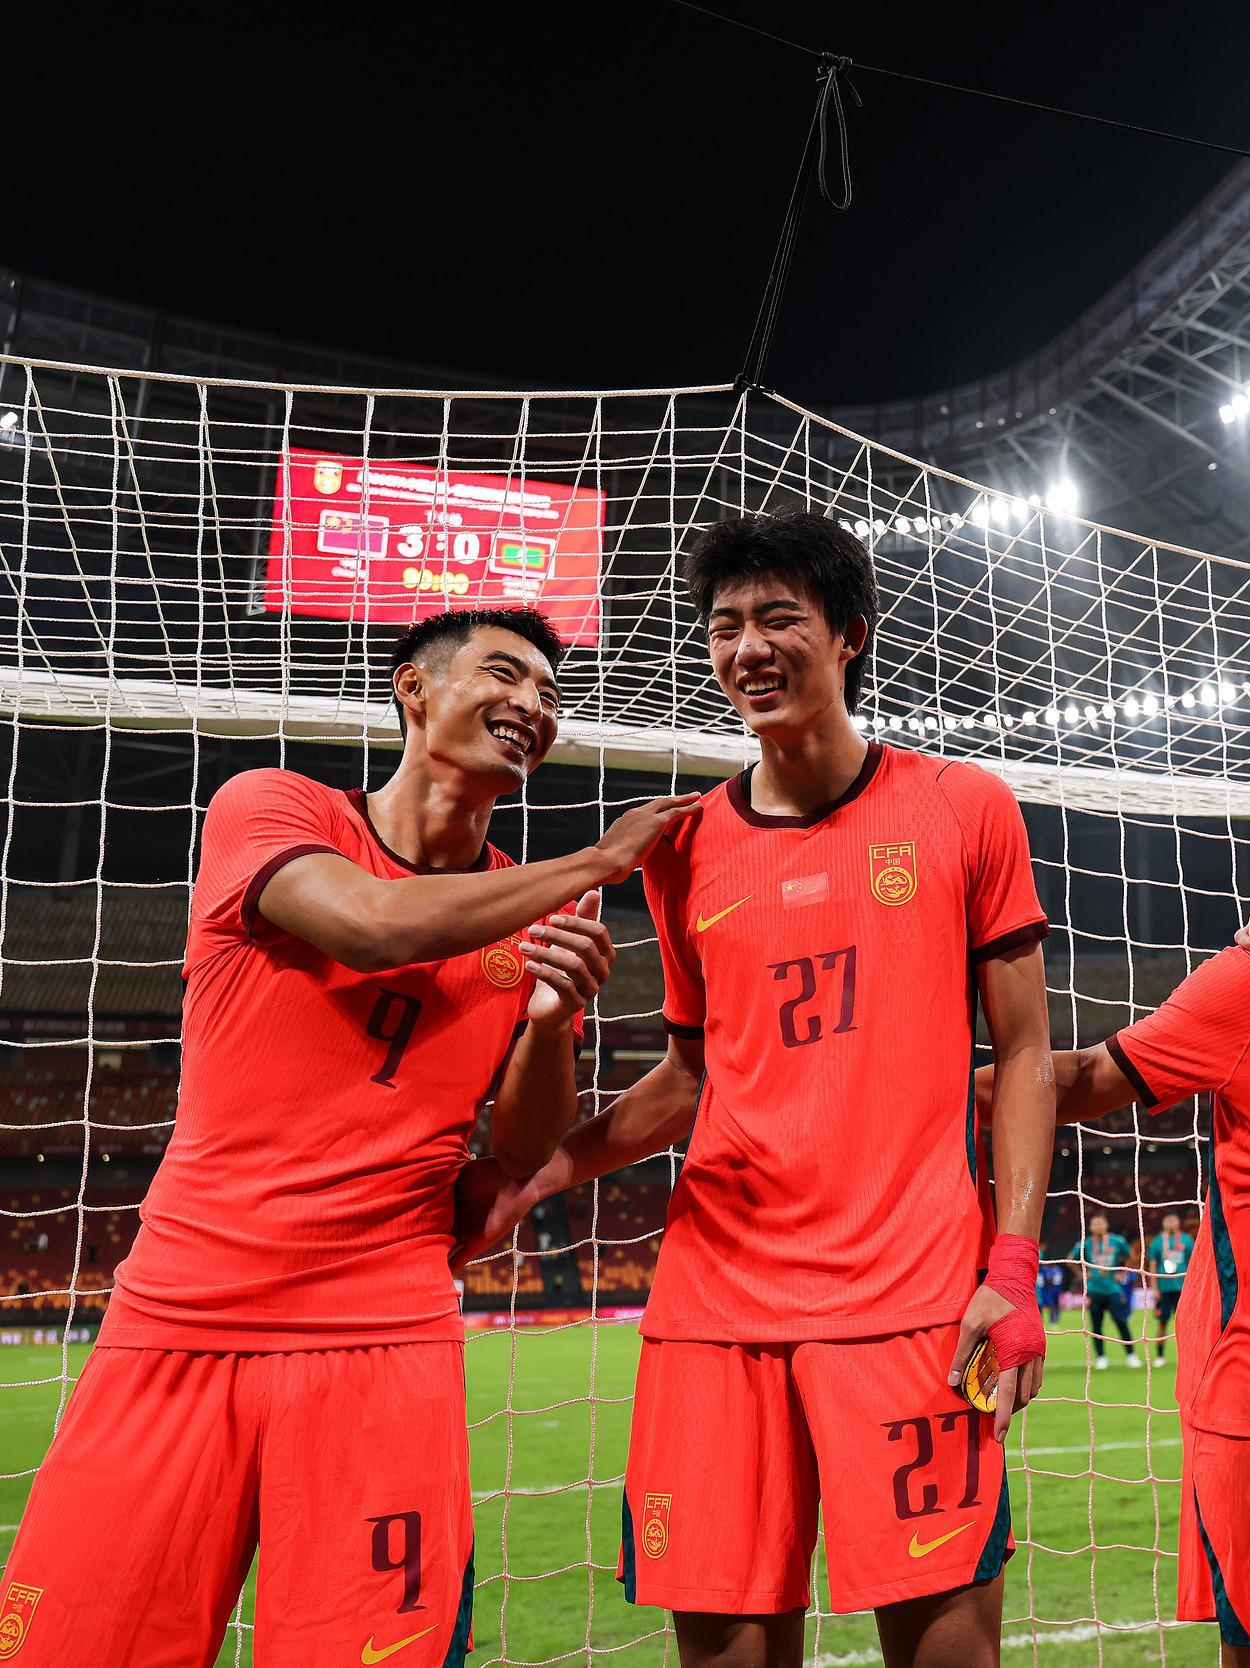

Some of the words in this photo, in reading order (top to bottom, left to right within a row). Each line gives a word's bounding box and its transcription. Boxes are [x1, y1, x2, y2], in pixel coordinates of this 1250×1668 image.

[873, 846, 911, 859] CFA
[366, 986, 423, 1089] 9
[766, 945, 858, 1048] 27
[647, 1497, 669, 1509] CFA
[880, 1408, 982, 1520] 27
[7, 1587, 38, 1606] CFA
[364, 1510, 427, 1615] 9
